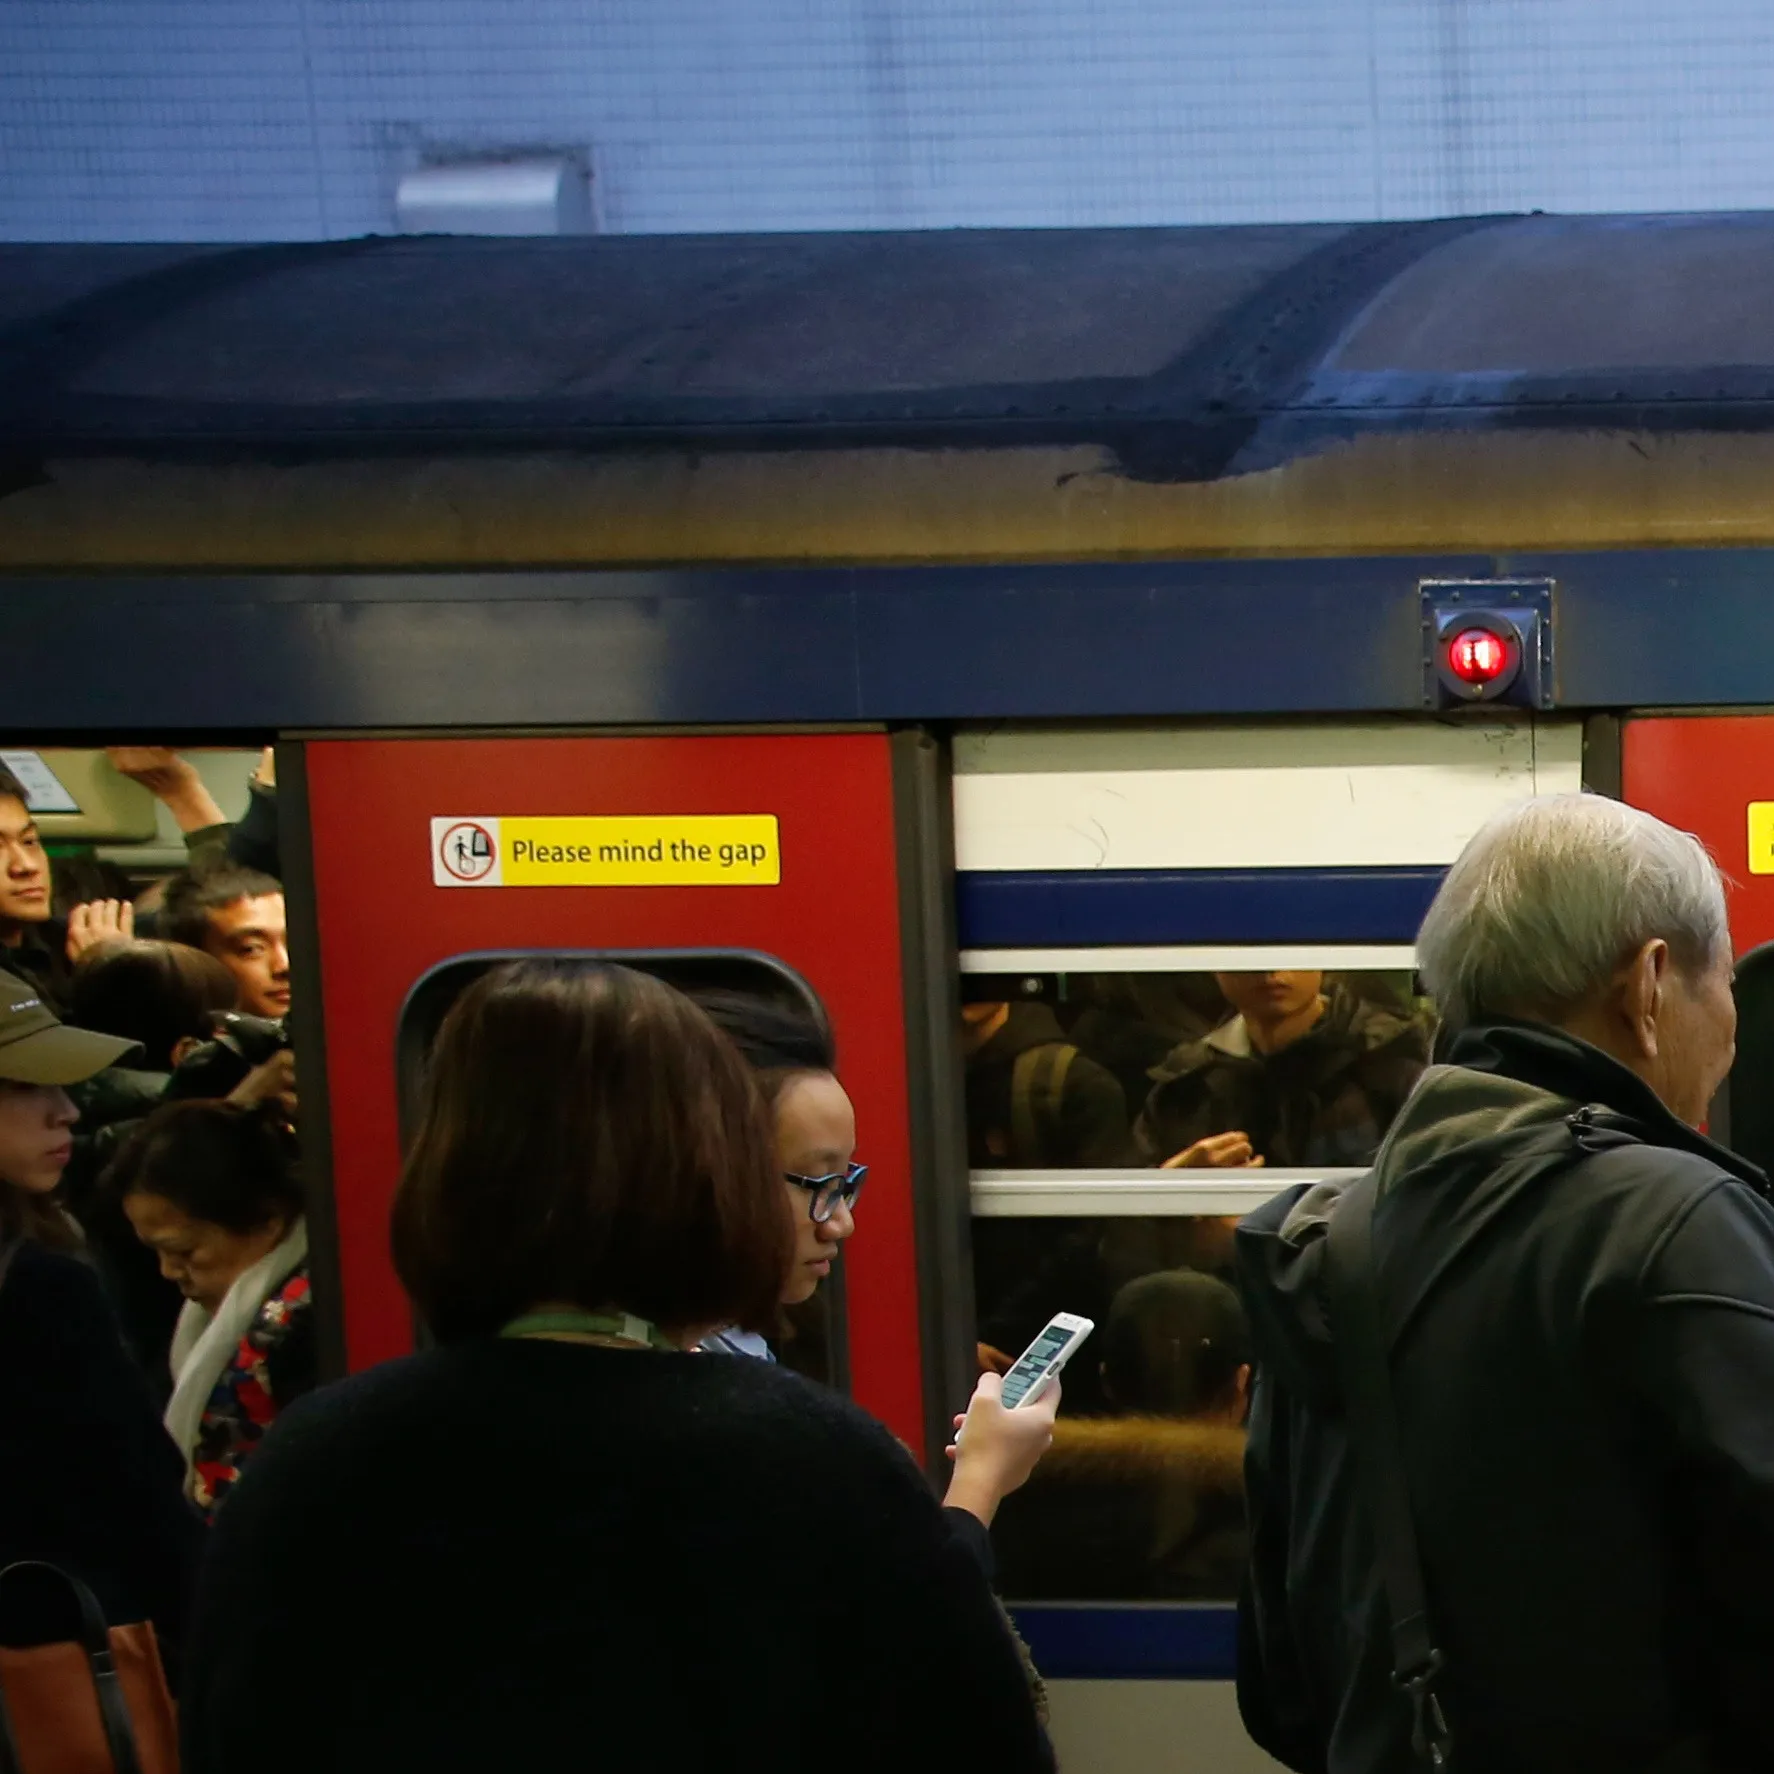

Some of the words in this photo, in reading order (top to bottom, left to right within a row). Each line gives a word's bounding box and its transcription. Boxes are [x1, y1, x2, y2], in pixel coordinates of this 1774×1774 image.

[512, 839, 592, 863] Please
[599, 837, 663, 863] mind
[669, 837, 711, 863] the
[718, 844, 766, 870] gap
